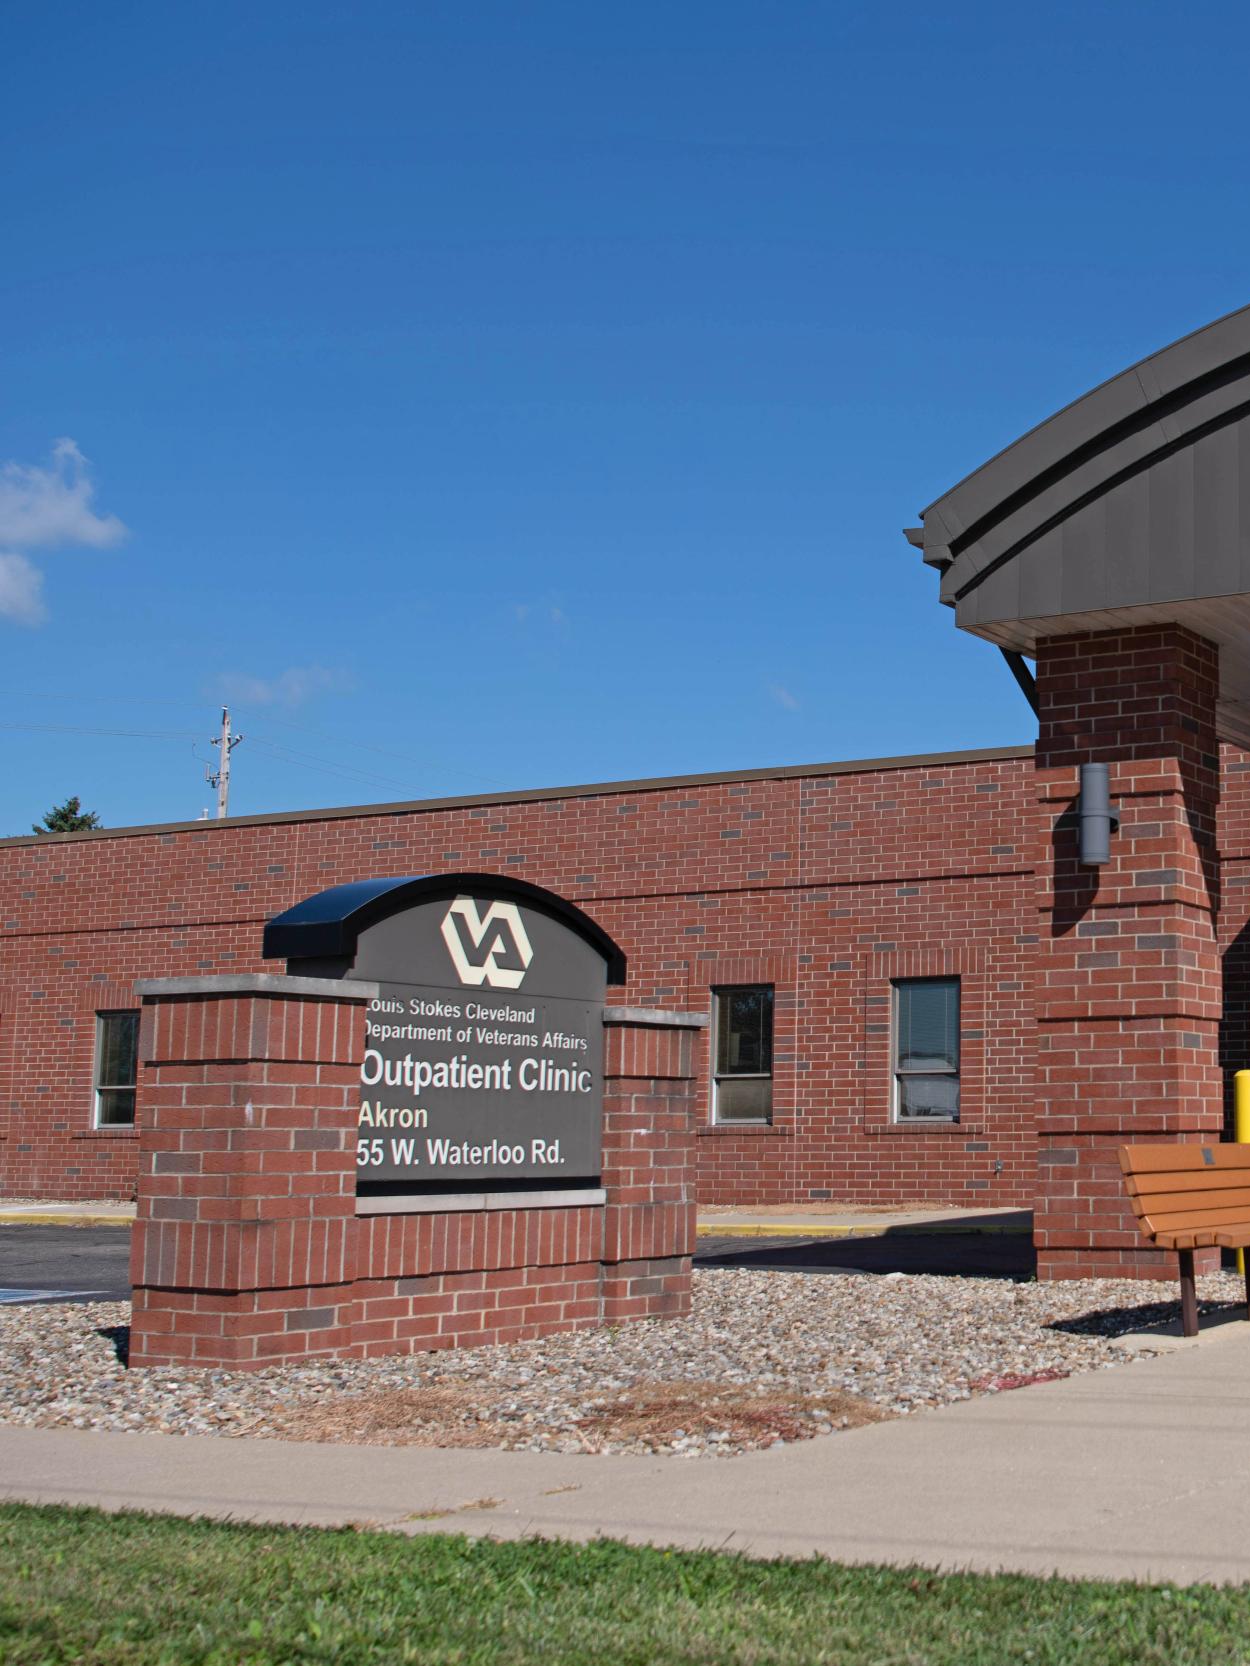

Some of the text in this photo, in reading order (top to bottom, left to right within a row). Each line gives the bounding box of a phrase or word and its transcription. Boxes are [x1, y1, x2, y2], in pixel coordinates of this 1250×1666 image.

[366, 998, 535, 1024] ouis Stokes Cleveland
[456, 1026, 472, 1043] of
[476, 1027, 538, 1047] Veterans
[542, 1031, 588, 1050] Affairs
[360, 1049, 592, 1095] Outpatient Clinic
[358, 1100, 428, 1128] Akron
[356, 1138, 565, 1166] 55 W. Waterloo Rd.
